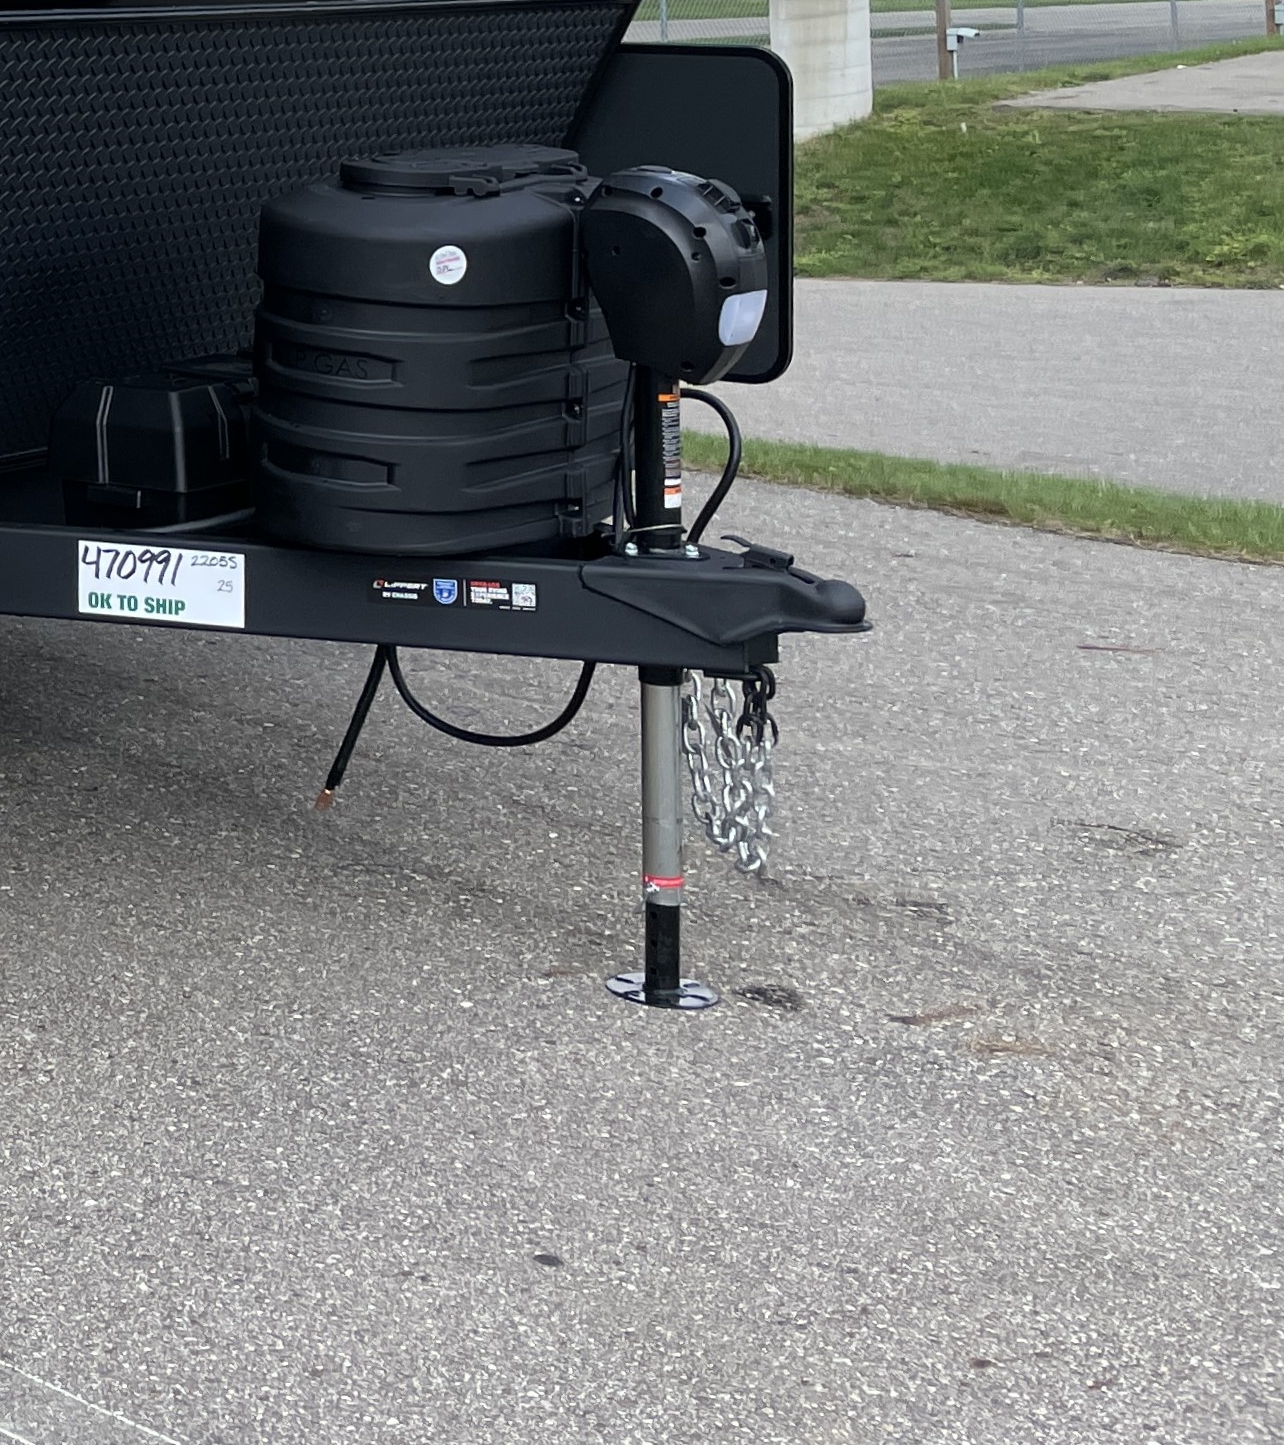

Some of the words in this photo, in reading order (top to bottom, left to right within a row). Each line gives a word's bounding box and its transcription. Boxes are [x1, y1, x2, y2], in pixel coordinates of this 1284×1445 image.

[314, 353, 368, 380] GAS
[81, 544, 184, 587] 470991
[217, 579, 234, 593] 25
[88, 591, 113, 610] OK
[117, 594, 139, 612] TO
[144, 596, 186, 616] SHIP
